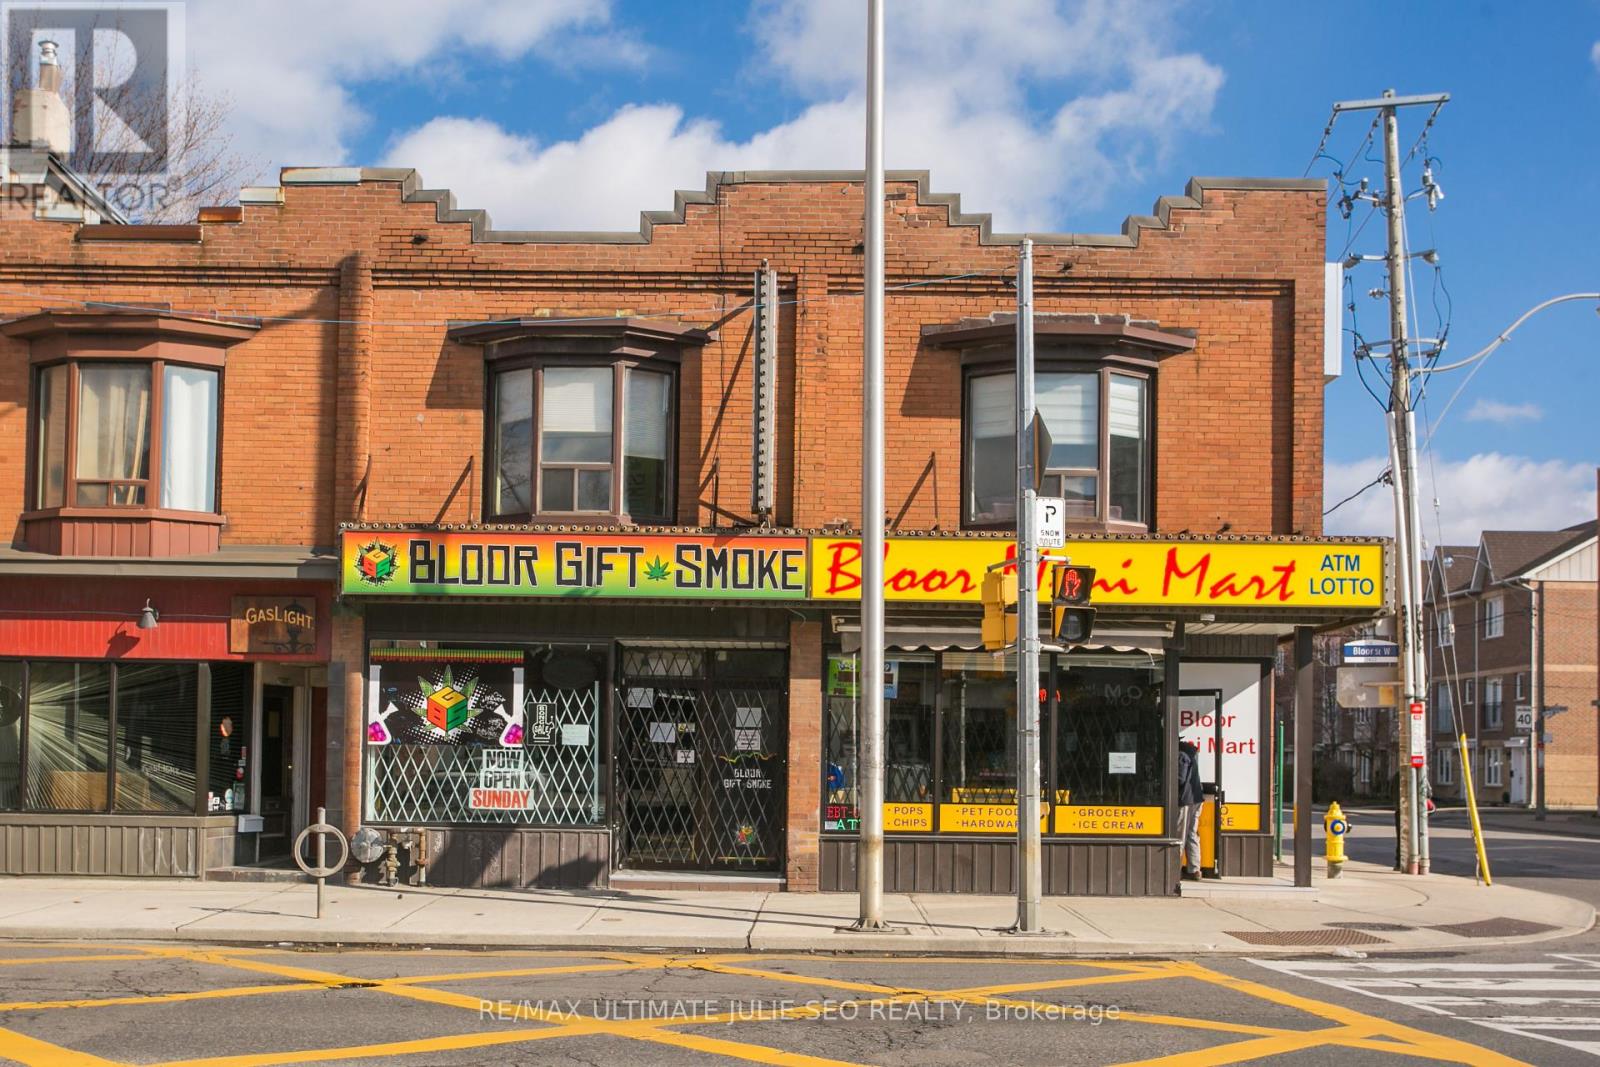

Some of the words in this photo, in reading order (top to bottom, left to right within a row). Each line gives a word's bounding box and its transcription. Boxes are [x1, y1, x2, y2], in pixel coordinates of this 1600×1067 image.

[408, 539, 538, 587] BLOOR
[555, 541, 645, 588] GIFT
[675, 543, 804, 591] SMOKE
[1320, 554, 1361, 572] ATM
[825, 542, 976, 595] Boor
[1162, 547, 1297, 602] Mart
[1309, 577, 1375, 597] LOTTO
[1353, 646, 1373, 656] Bloor
[1384, 647, 1391, 655] W
[1517, 713, 1532, 725] 40
[486, 751, 521, 769] NOW
[484, 771, 521, 789] OPEN
[472, 789, 530, 809] SUNDAY
[894, 806, 923, 815] POPS
[962, 807, 983, 816] PET
[1079, 808, 1136, 817] GROCERY
[837, 819, 862, 831] AT
[894, 818, 928, 827] CHIPS
[1079, 820, 1098, 829] ICE
[1103, 820, 1144, 830] CREAM
